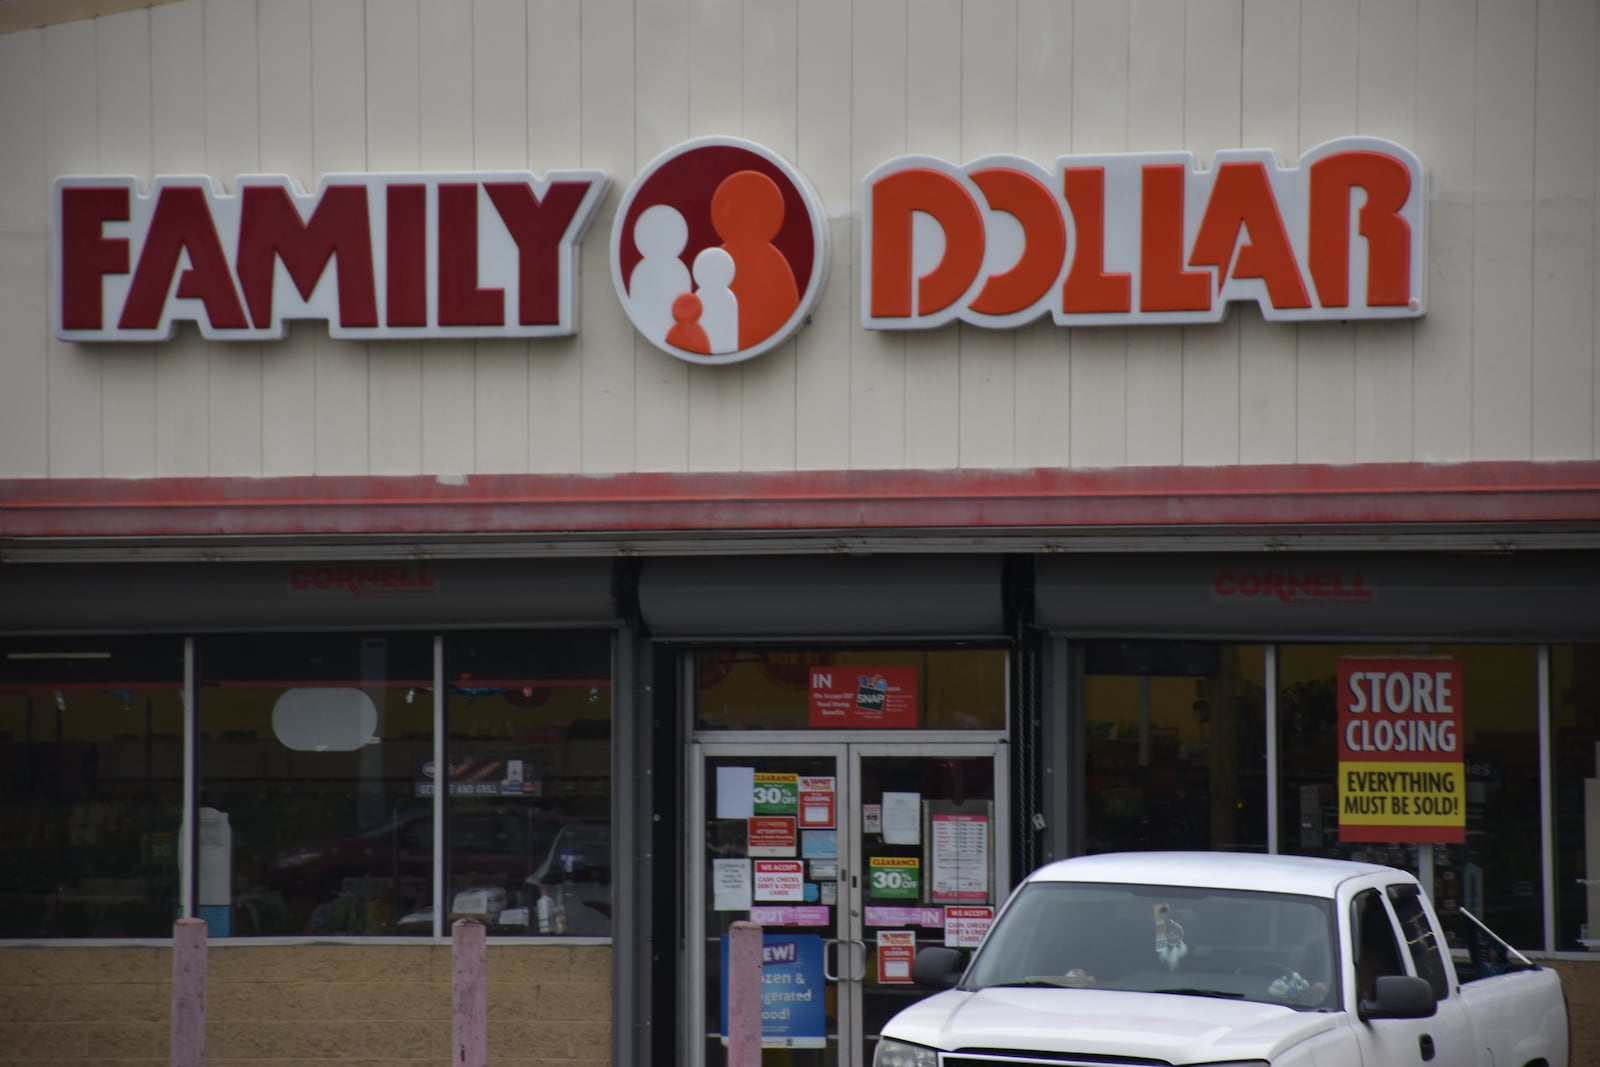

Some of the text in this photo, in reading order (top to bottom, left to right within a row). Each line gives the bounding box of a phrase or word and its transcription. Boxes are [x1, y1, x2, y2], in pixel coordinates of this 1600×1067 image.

[62, 151, 1411, 329] FAMILY DOLLAR
[290, 562, 435, 595] CORNELL
[1214, 571, 1373, 603] CORNELL
[813, 673, 832, 689] IN
[857, 694, 885, 704] SNAP
[1349, 672, 1454, 713] STORE
[1346, 720, 1456, 752] CLOSING
[1348, 772, 1455, 793] EVERYTHING
[1344, 796, 1459, 815] MUST BE SOLD!
[922, 911, 939, 924] IN
[763, 944, 795, 961] EW!
[762, 973, 805, 984] zen &
[763, 989, 812, 1005] gerated
[762, 1008, 790, 1020] ood!
